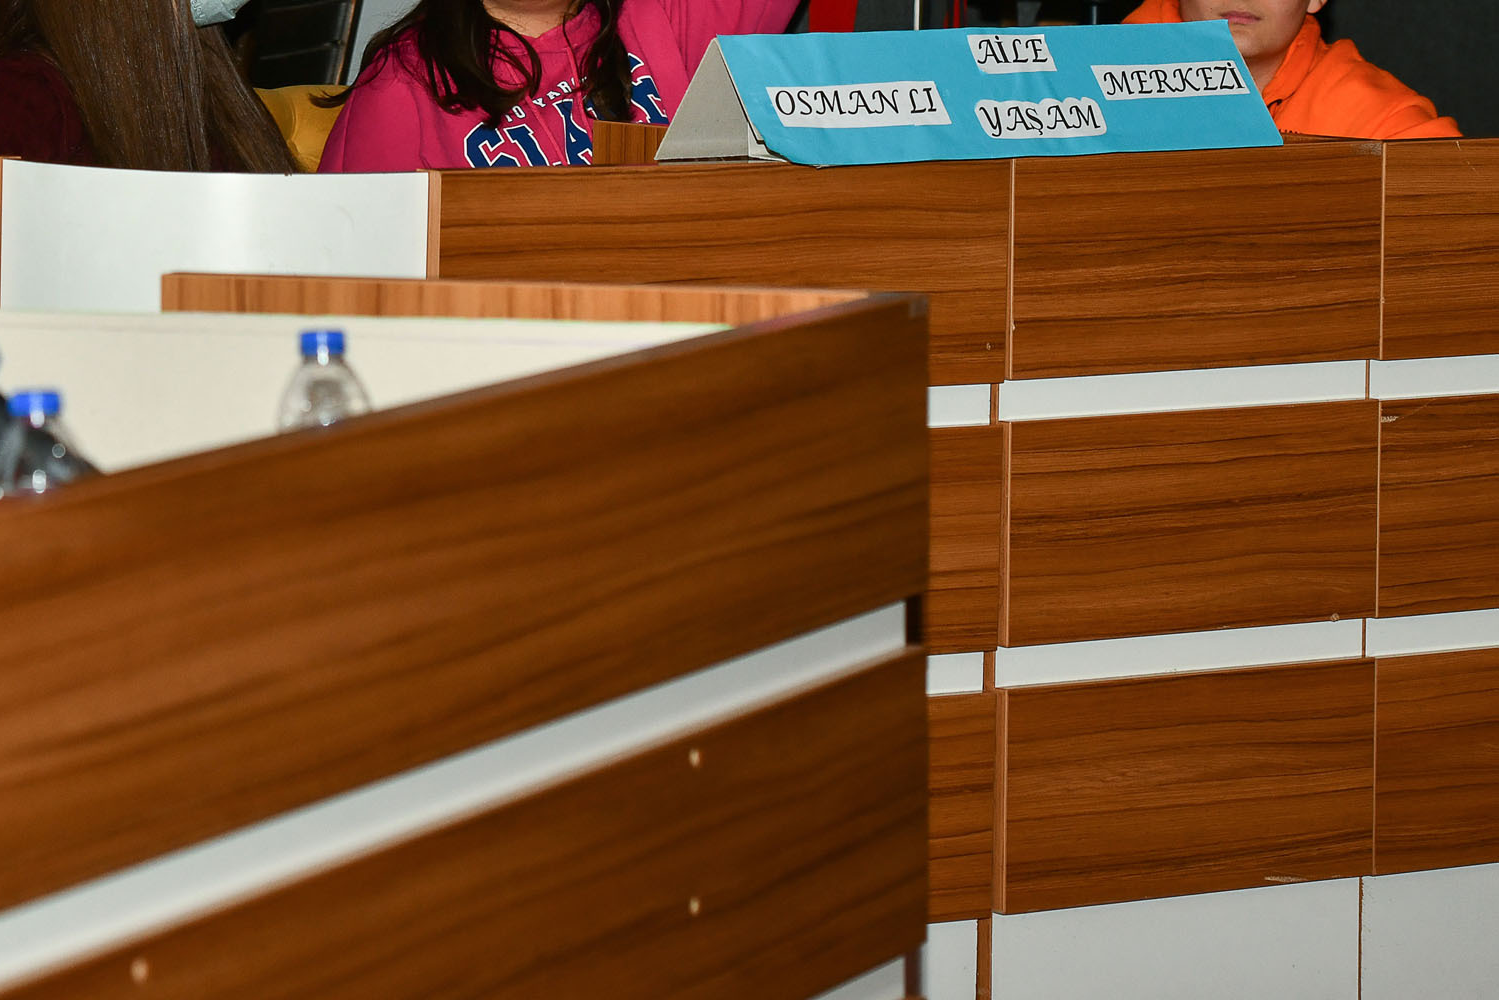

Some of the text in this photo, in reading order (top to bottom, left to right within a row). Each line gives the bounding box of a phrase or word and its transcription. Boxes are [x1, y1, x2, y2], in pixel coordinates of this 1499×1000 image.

[976, 35, 1049, 65] AİLE
[1102, 61, 1246, 96] MERKEZİ
[978, 104, 1101, 137] YAŞAM
